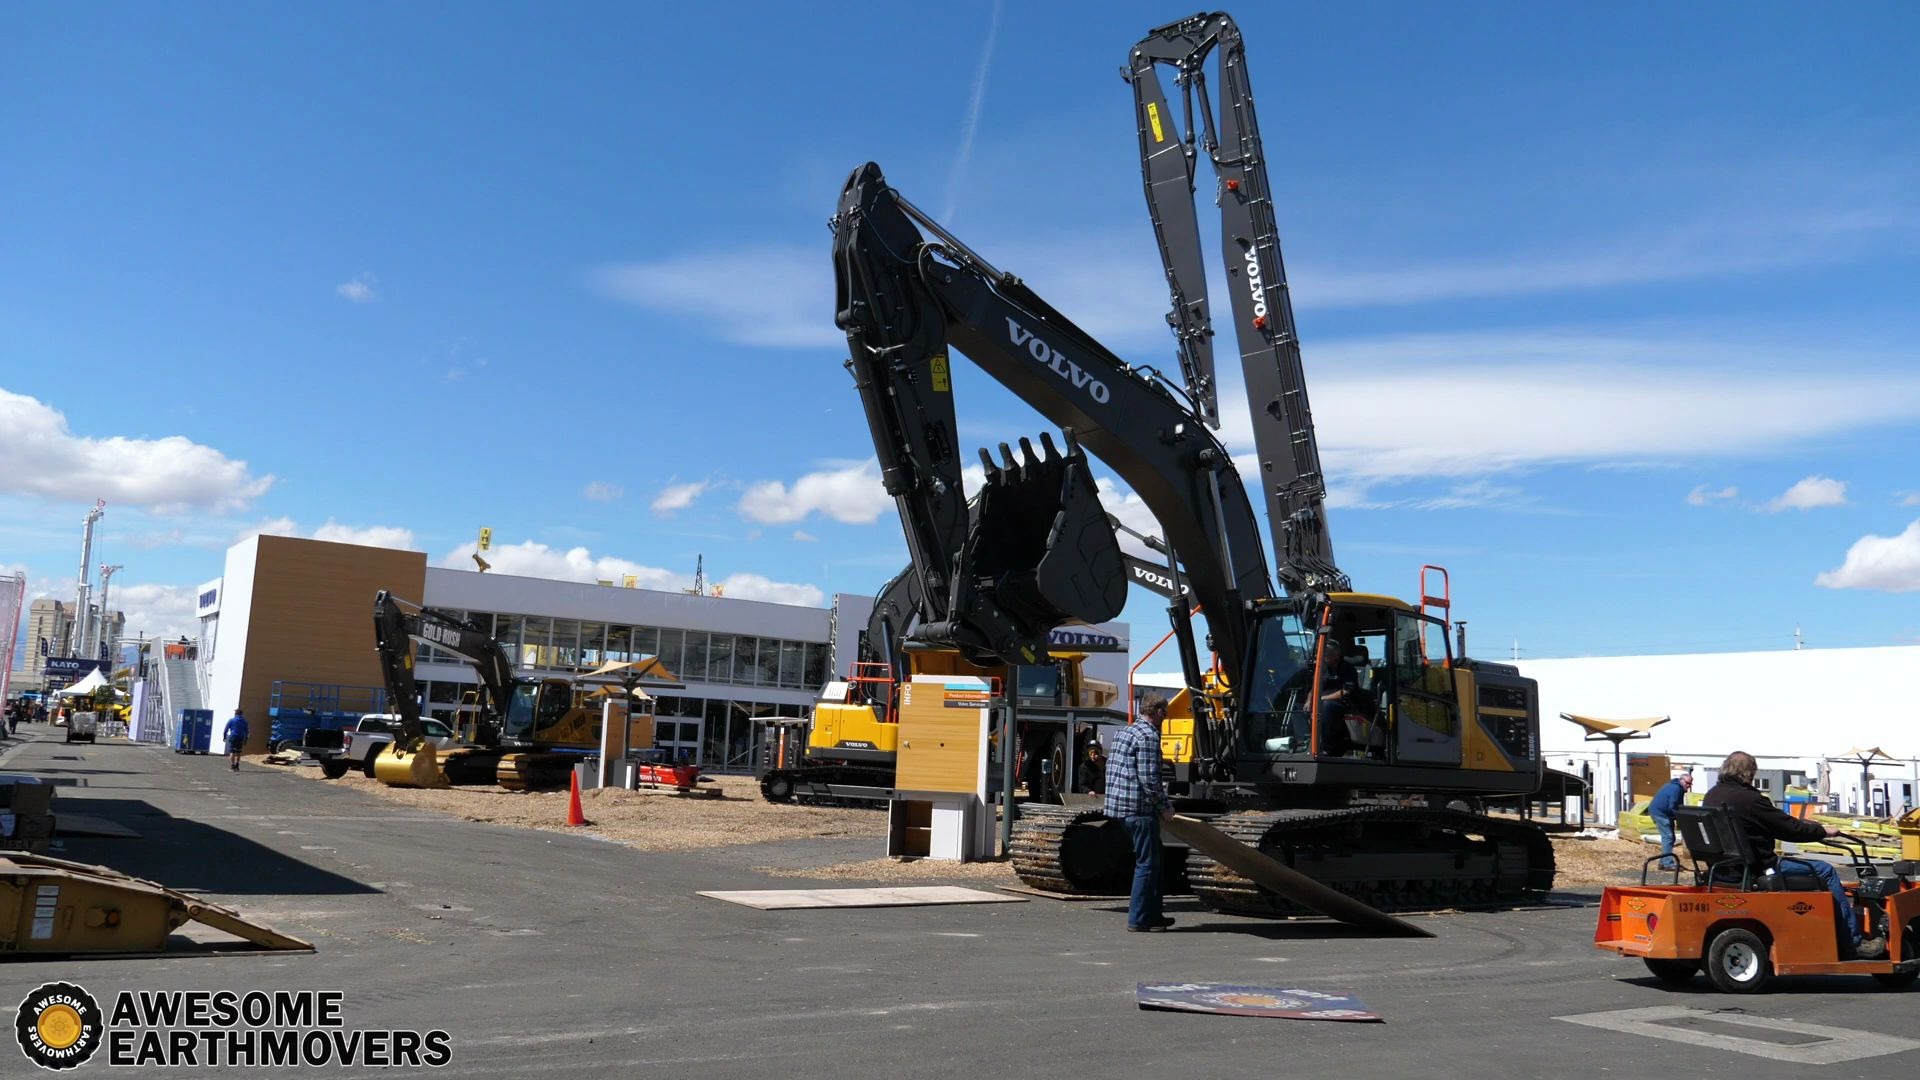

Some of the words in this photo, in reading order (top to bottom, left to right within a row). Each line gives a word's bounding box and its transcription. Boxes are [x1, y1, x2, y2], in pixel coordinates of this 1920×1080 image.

[1244, 245, 1267, 318] VOLVO
[1005, 316, 1110, 404] VOLVO
[422, 622, 442, 642] GOLD
[442, 628, 461, 648] RUSH
[50, 661, 80, 669] KATO
[903, 684, 912, 705] INFO
[1679, 902, 1710, 913] 137481
